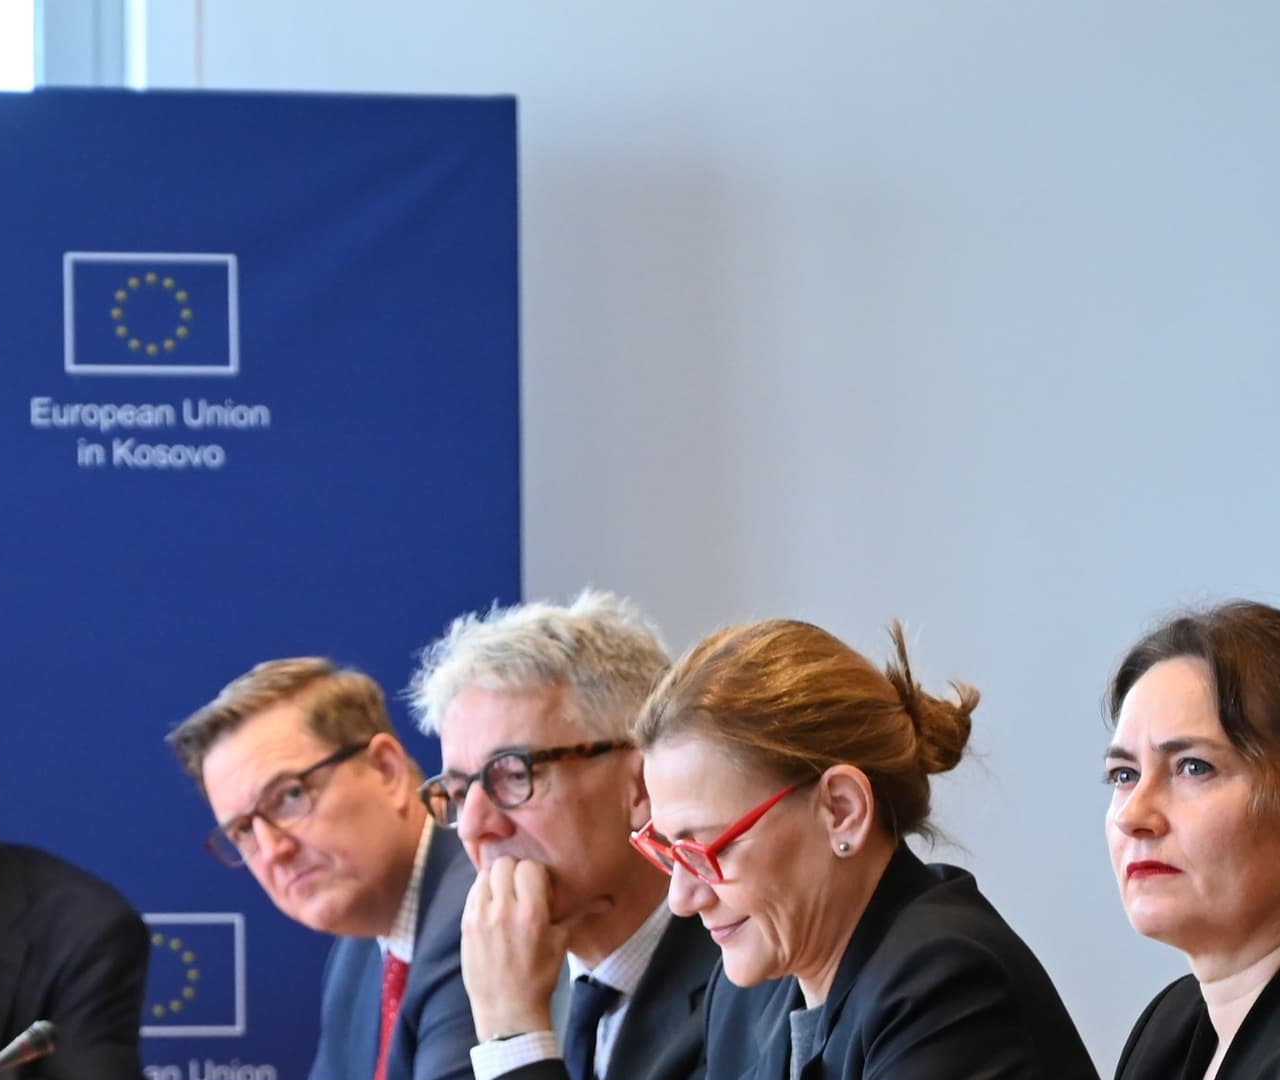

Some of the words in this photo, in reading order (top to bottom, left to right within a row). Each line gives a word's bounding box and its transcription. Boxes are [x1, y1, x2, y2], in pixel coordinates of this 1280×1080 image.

[30, 396, 176, 432] European
[183, 398, 271, 429] Union
[77, 437, 104, 467] in
[112, 438, 226, 468] Kosovo
